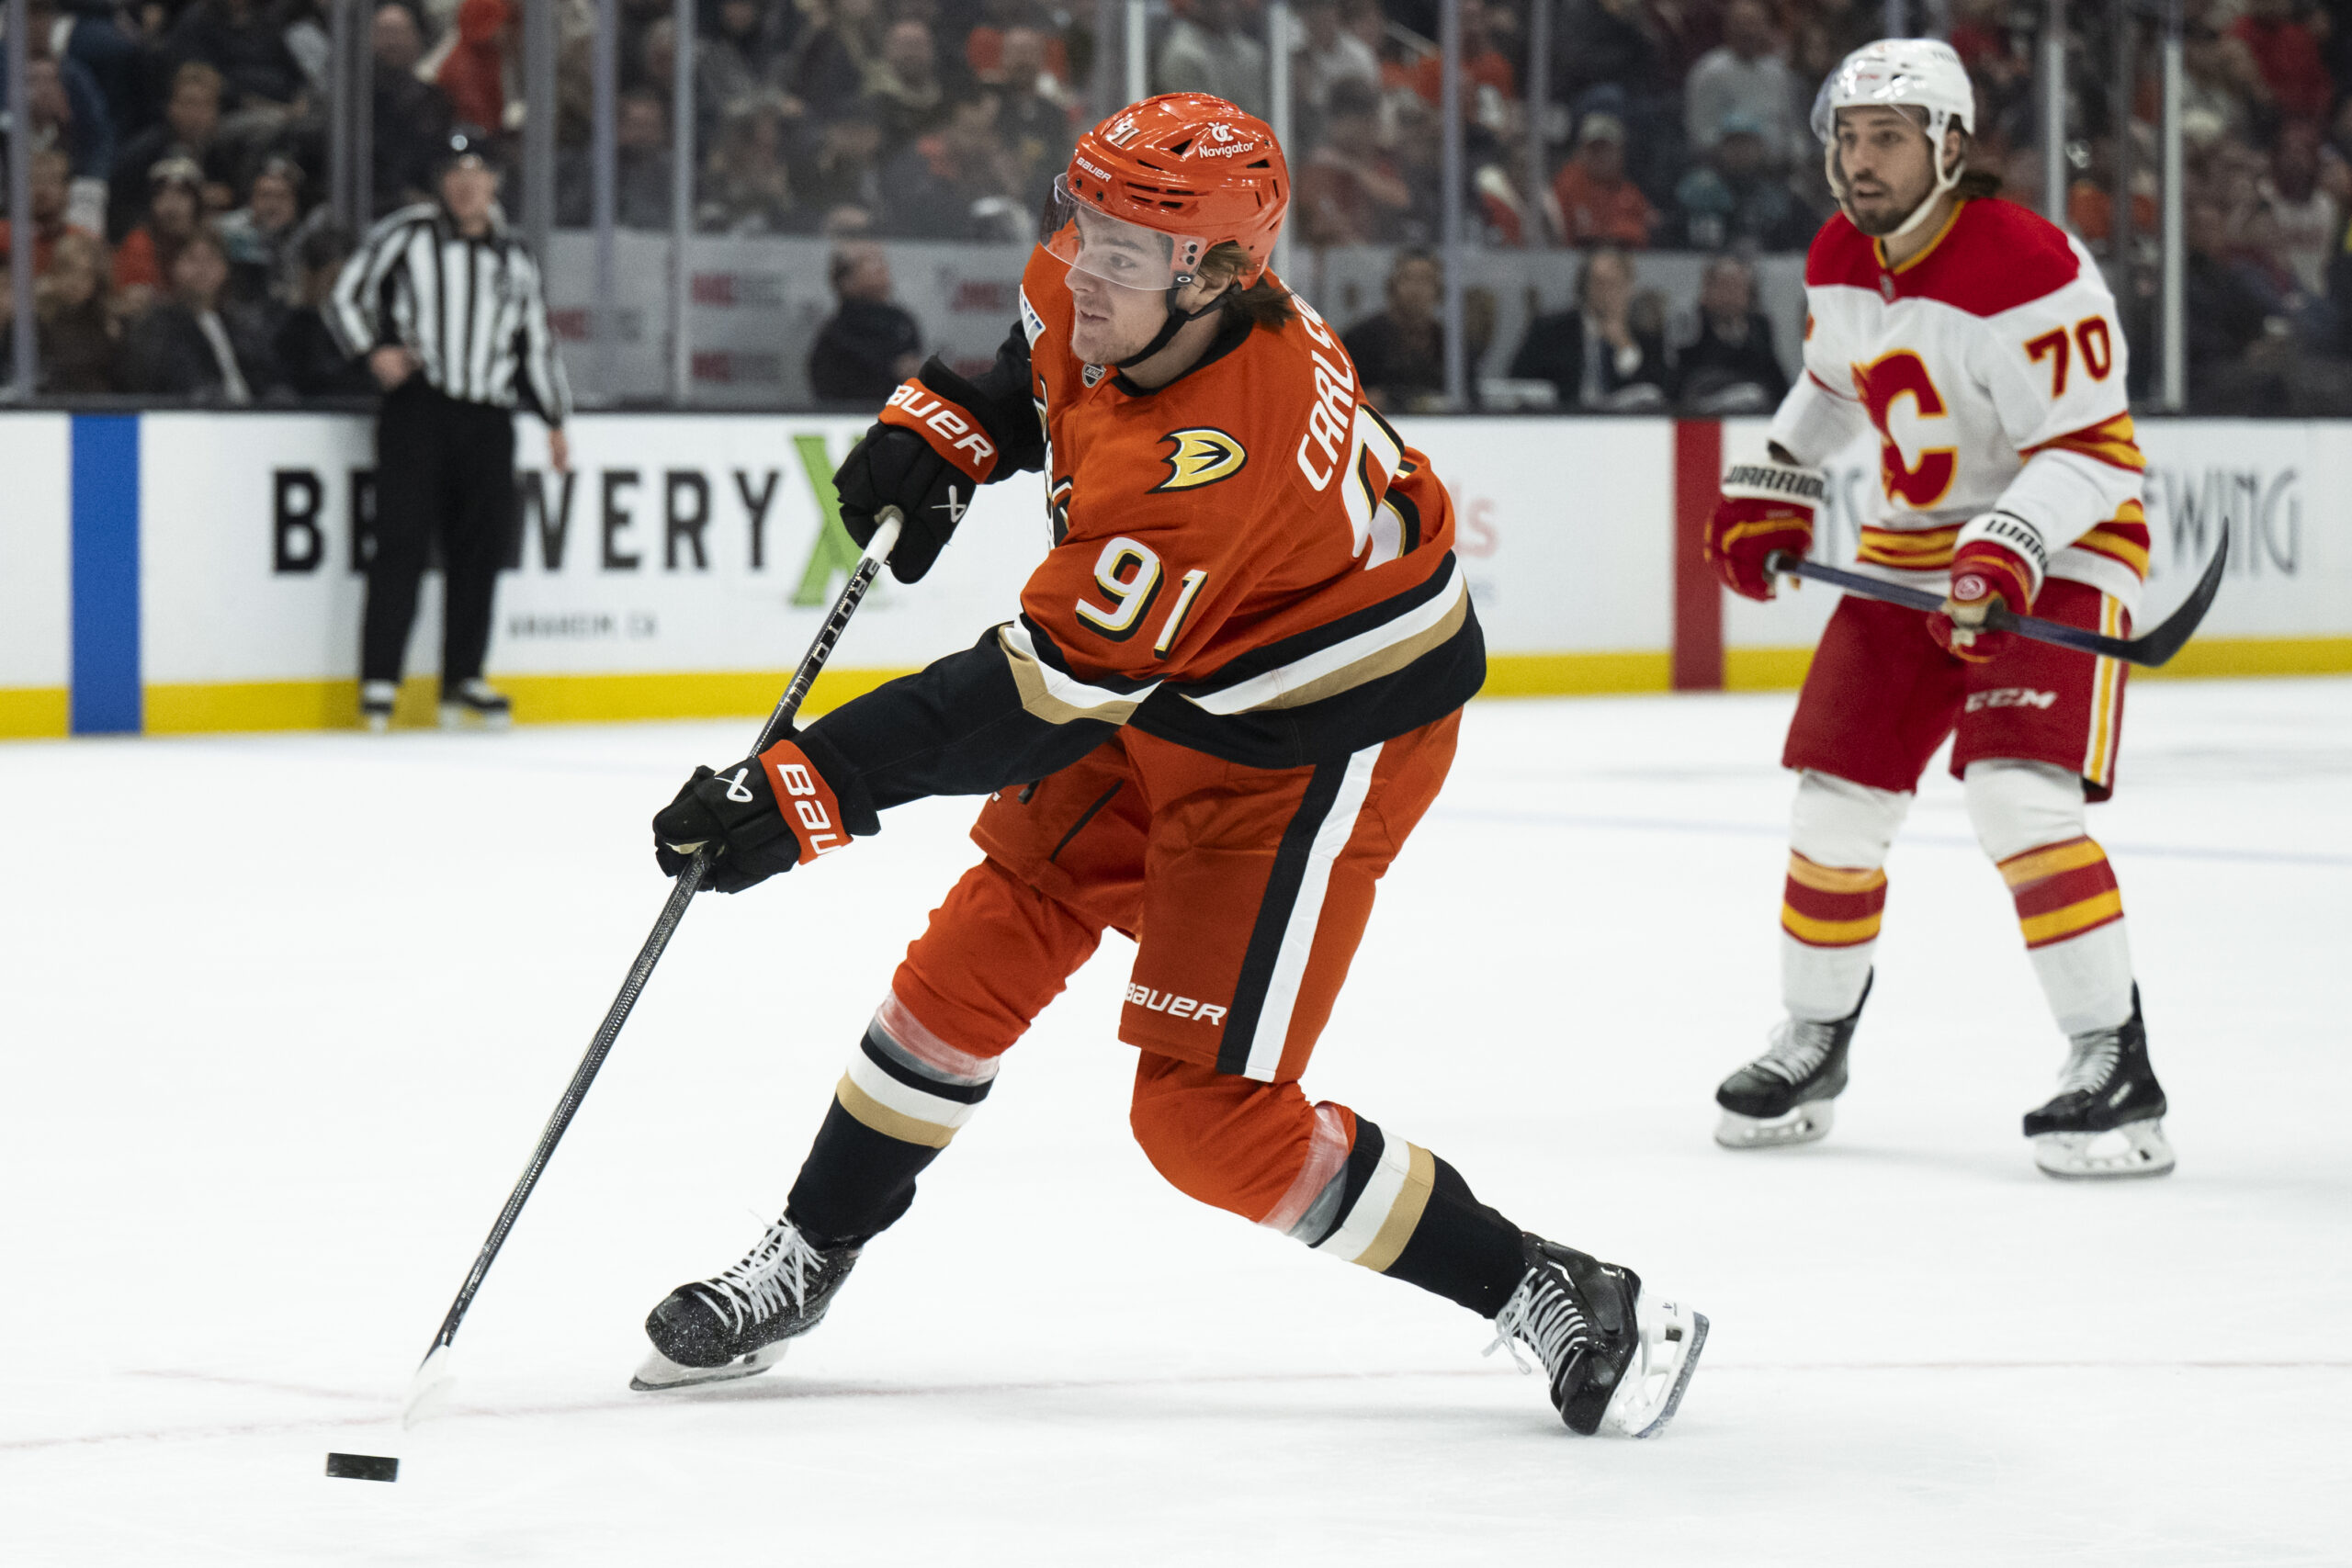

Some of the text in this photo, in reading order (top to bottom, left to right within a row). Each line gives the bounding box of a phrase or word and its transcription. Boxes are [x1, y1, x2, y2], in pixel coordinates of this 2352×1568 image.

[1198, 141, 1254, 158] Navigator
[2023, 314, 2112, 400] 70
[1075, 536, 1208, 660] 91
[1964, 688, 2057, 713] CCM
